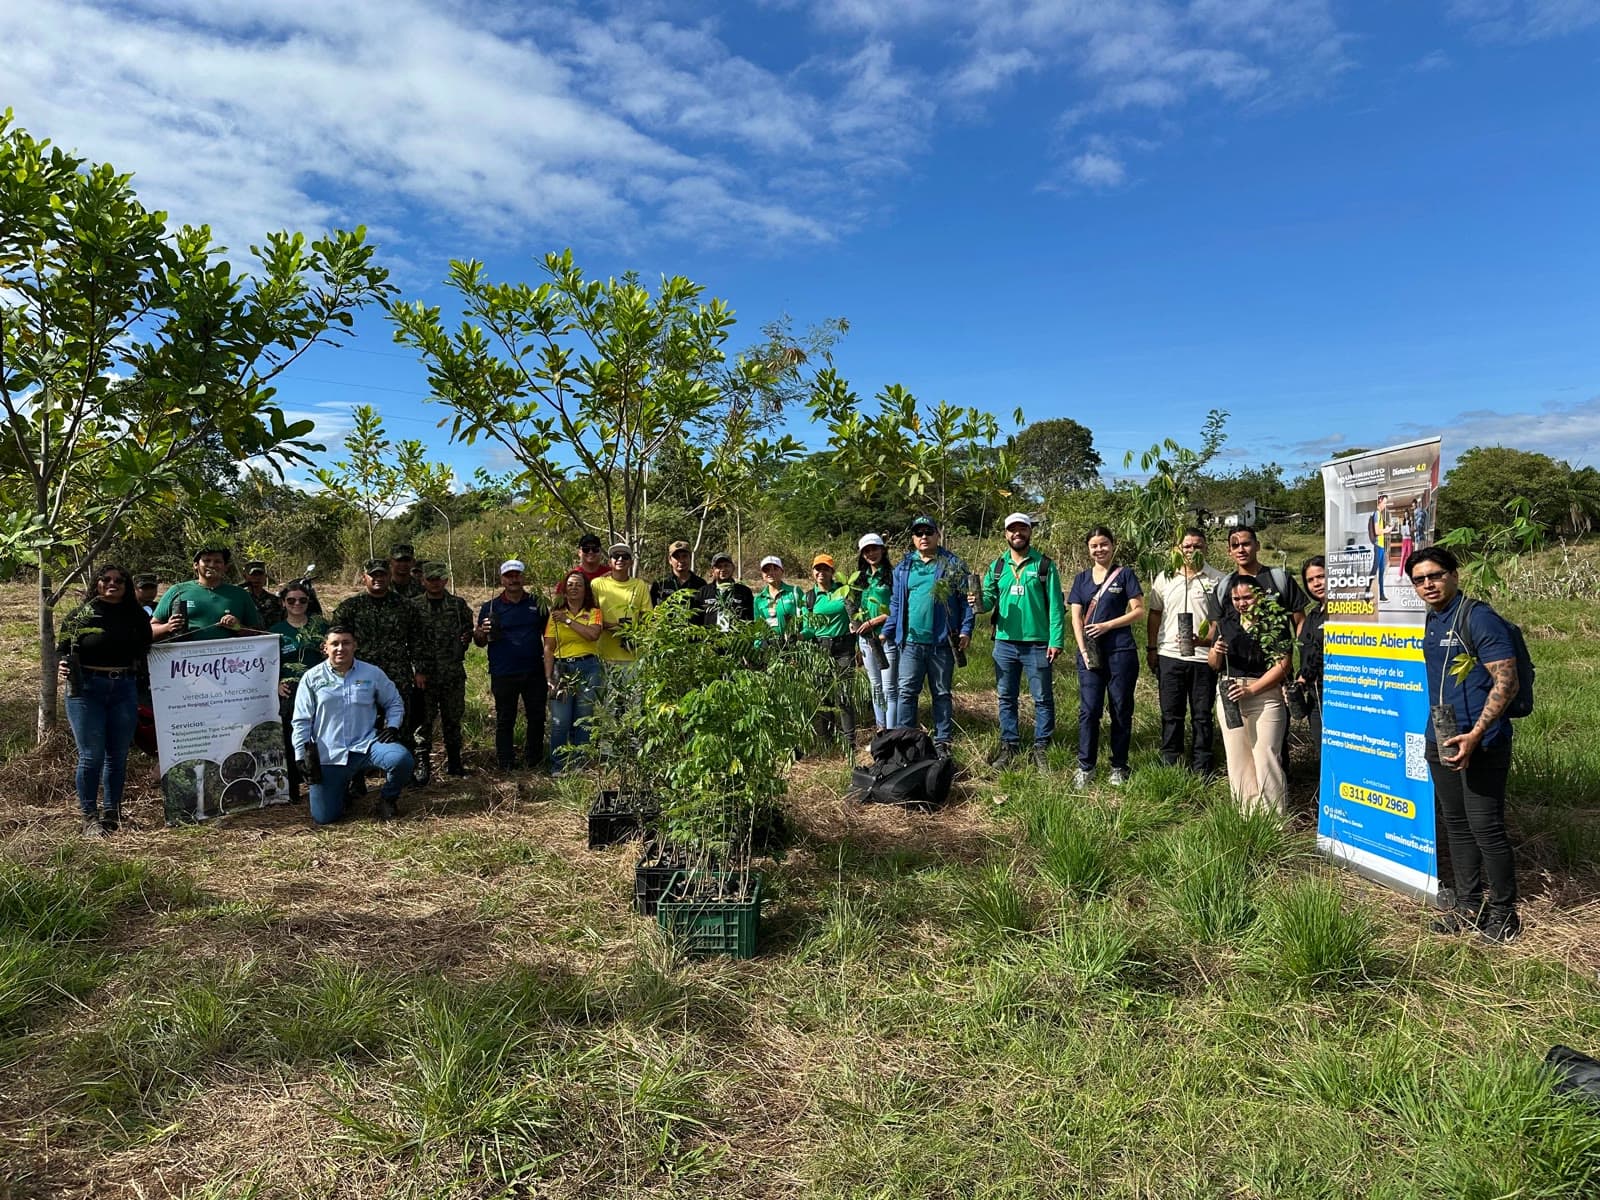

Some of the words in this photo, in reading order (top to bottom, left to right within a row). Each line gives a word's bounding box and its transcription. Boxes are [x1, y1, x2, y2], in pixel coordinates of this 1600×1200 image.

[1416, 463, 1427, 471] 4.0
[1344, 468, 1385, 481] UNIMINUTO
[1339, 553, 1372, 561] UNIMINUTO
[1328, 567, 1345, 576] Tengo
[1346, 566, 1351, 575] el
[1327, 575, 1375, 590] poder
[1328, 592, 1335, 600] de
[1336, 592, 1357, 602] romper
[1327, 601, 1374, 614] BARRERAS
[1379, 632, 1425, 649] Abierta
[171, 656, 265, 680] Miraflores
[1361, 664, 1368, 672] lo
[1369, 666, 1388, 677] mejor
[1388, 668, 1396, 676] de
[1396, 669, 1404, 677] la
[1358, 676, 1378, 687] digital
[182, 693, 209, 701] Vereda
[224, 687, 259, 696] Mercedes
[171, 721, 205, 730] Servicios:
[1341, 731, 1362, 741] nuestros
[1362, 734, 1391, 747] Pregrados
[1328, 738, 1344, 747] Centro
[1344, 741, 1376, 755] Universitario
[1349, 786, 1365, 801] 311
[1367, 792, 1383, 807] 490
[1385, 796, 1409, 814] 2968
